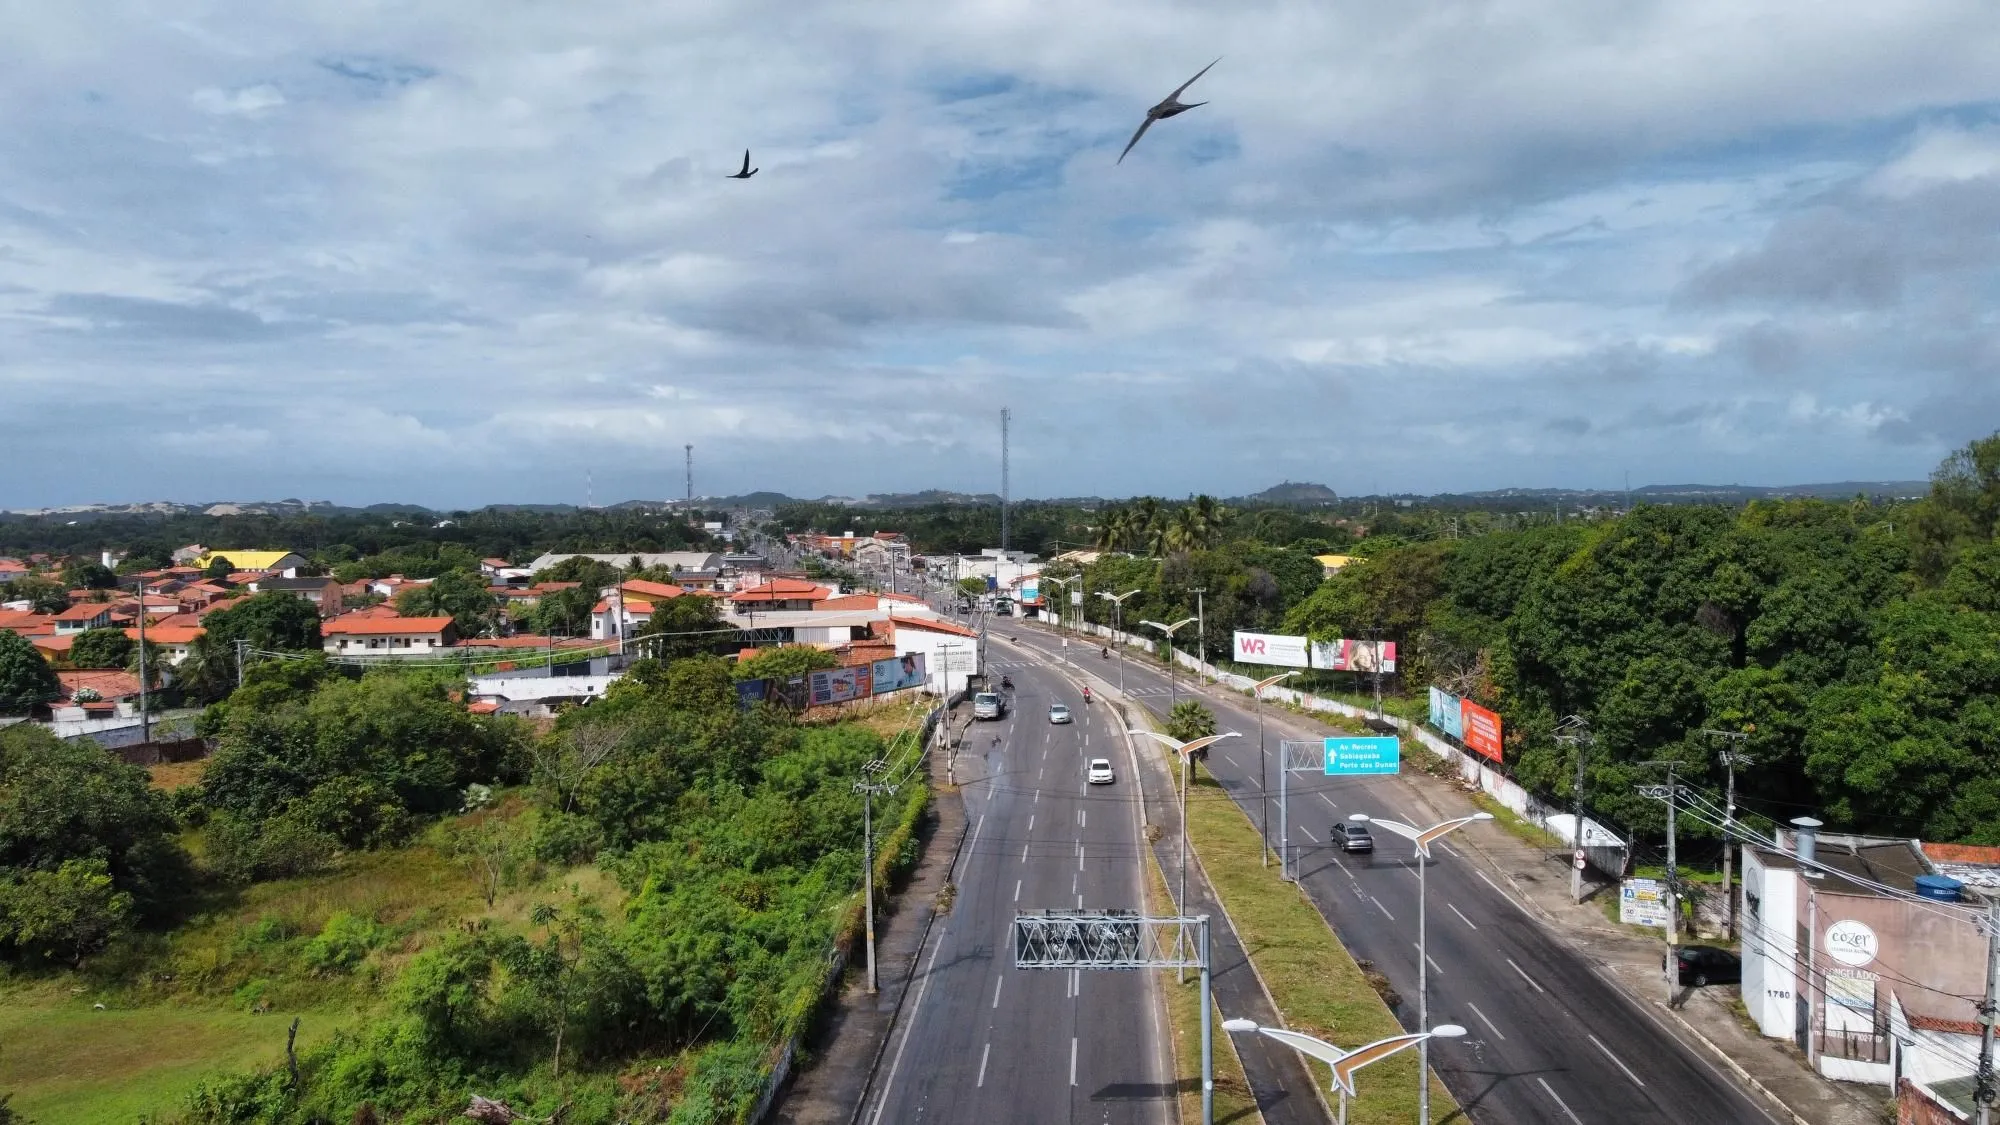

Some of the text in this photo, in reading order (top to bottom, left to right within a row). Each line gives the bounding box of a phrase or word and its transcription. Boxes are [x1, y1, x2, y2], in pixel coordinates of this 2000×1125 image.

[1240, 637, 1266, 655] WR
[1832, 932, 1871, 948] cozer
[1767, 989, 1791, 999] 1780
